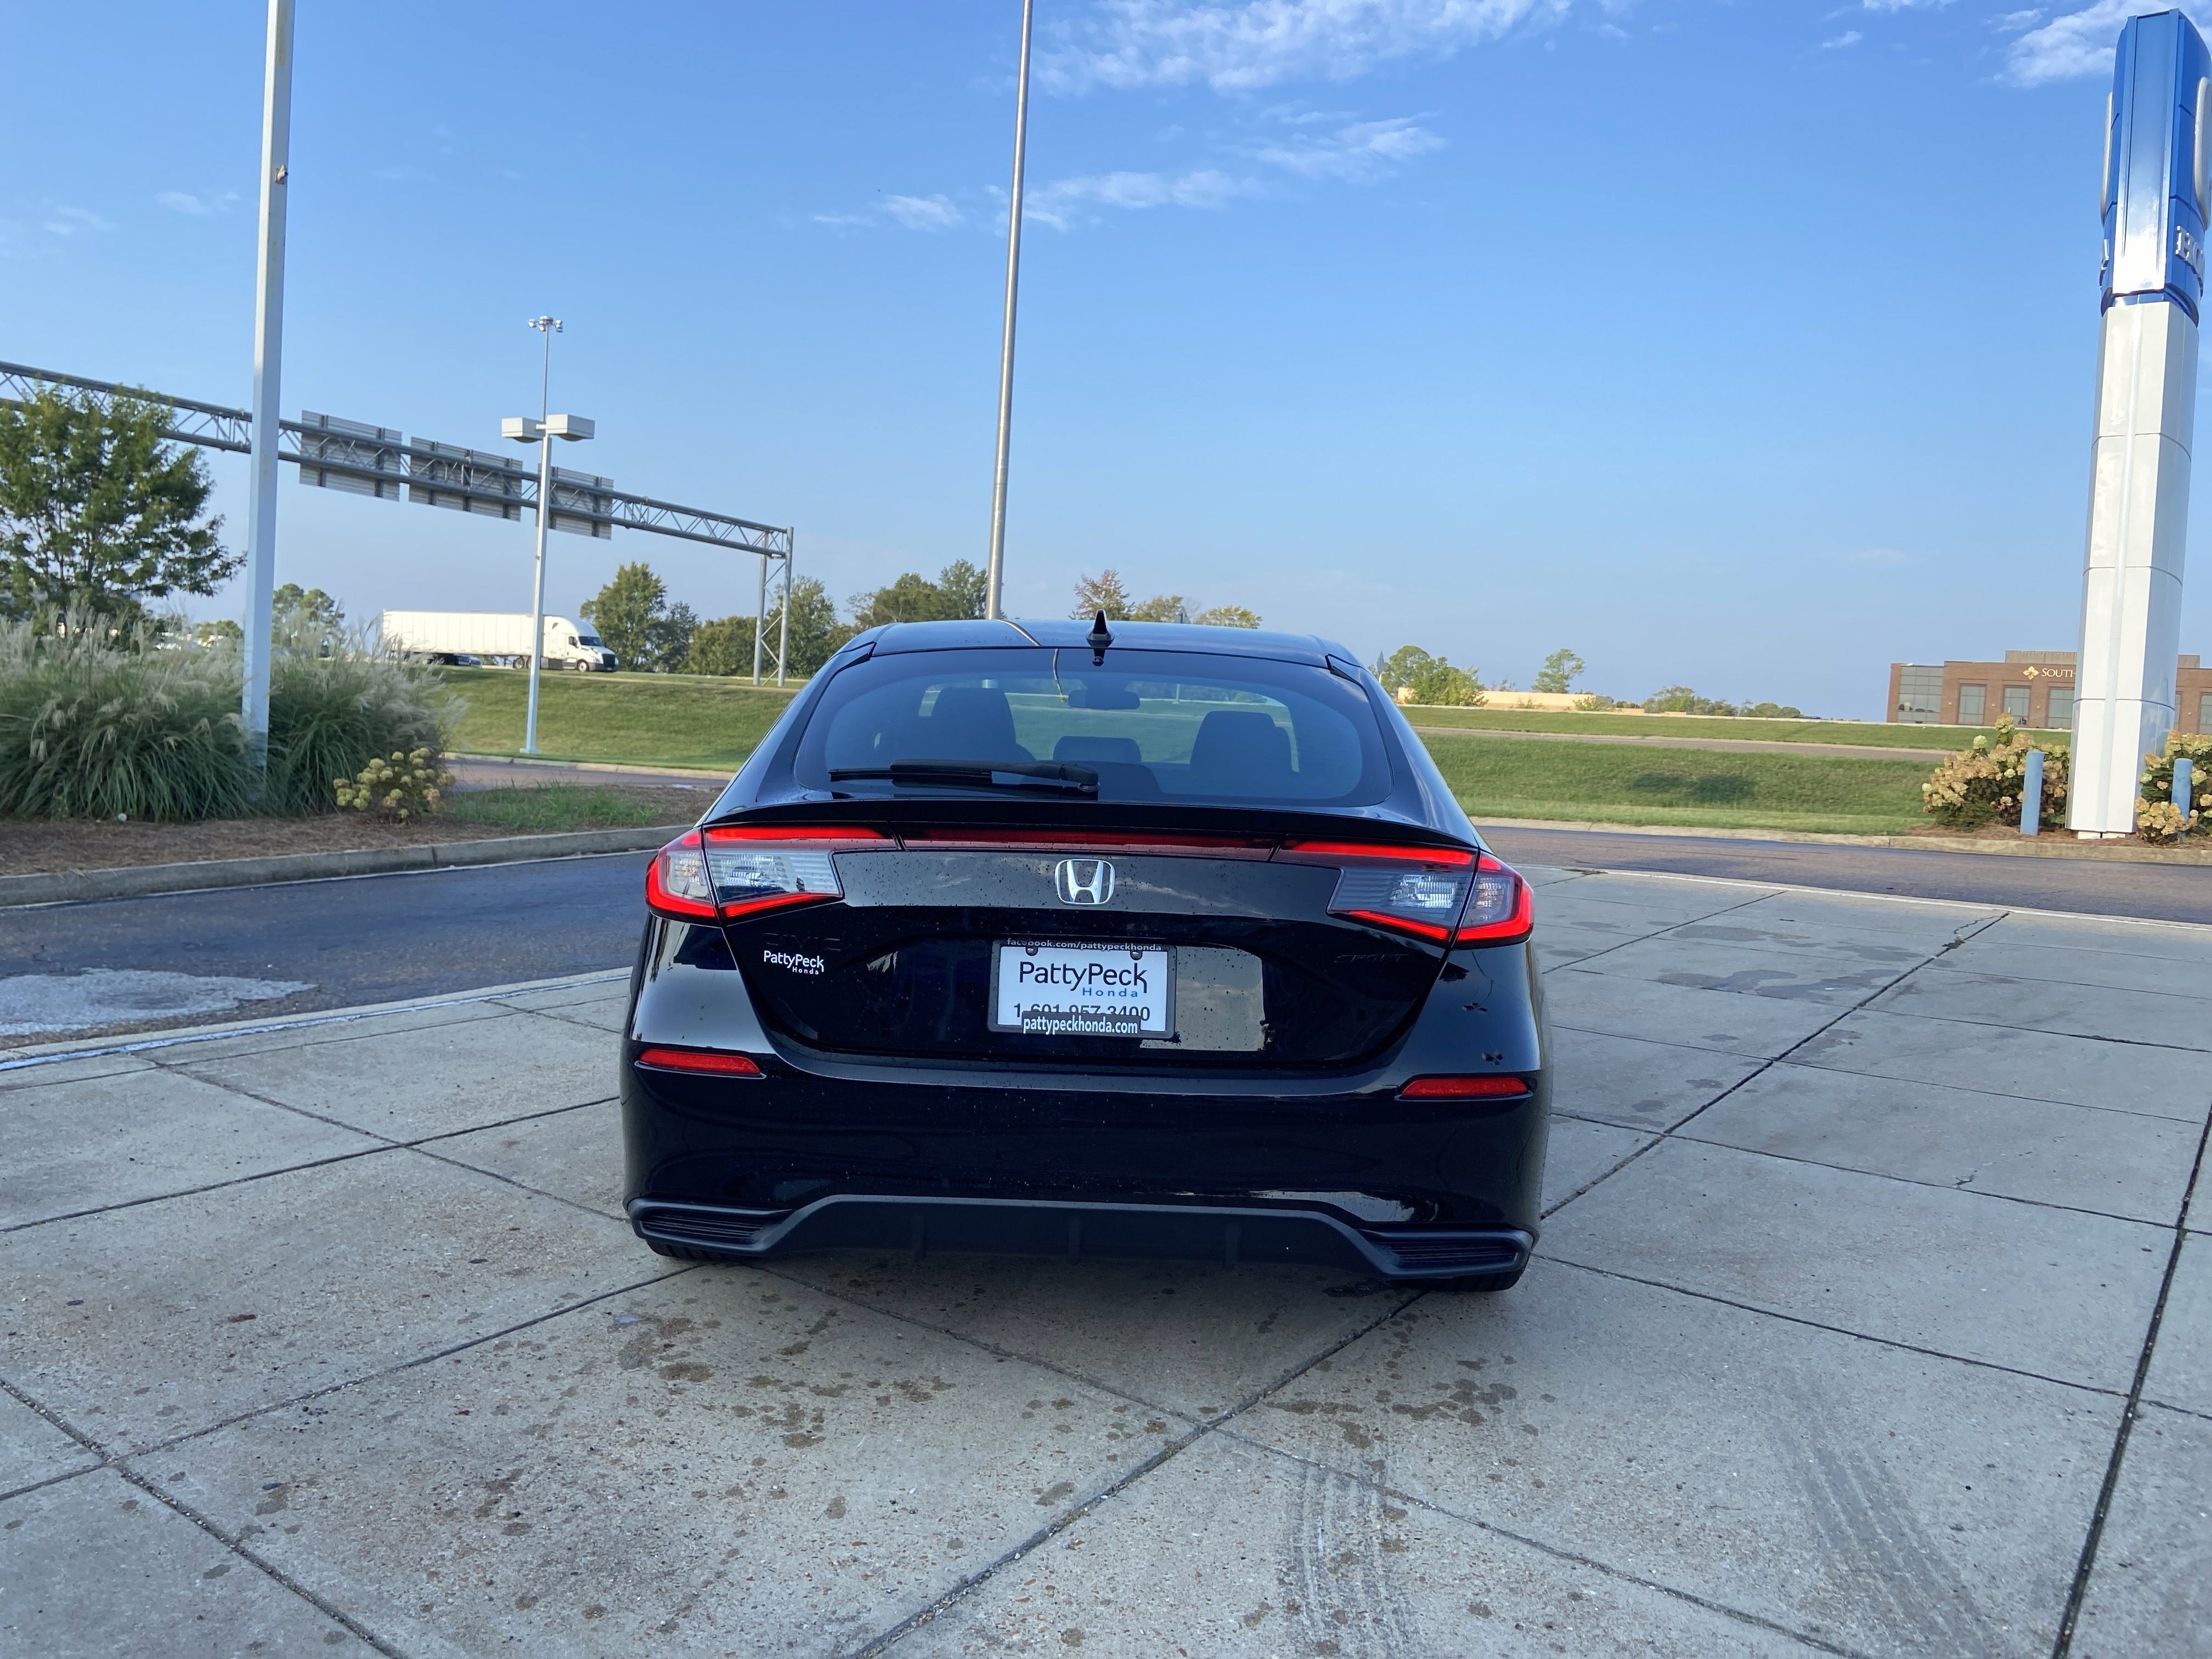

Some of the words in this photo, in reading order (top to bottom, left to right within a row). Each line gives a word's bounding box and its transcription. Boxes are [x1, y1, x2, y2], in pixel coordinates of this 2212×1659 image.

[764, 950, 824, 972] PattyPeck
[792, 967, 819, 975] Honda
[1019, 961, 1147, 994] PattyPeck
[1082, 987, 1138, 997] Honda
[1023, 1015, 1138, 1035] pattypeckhonda.com
